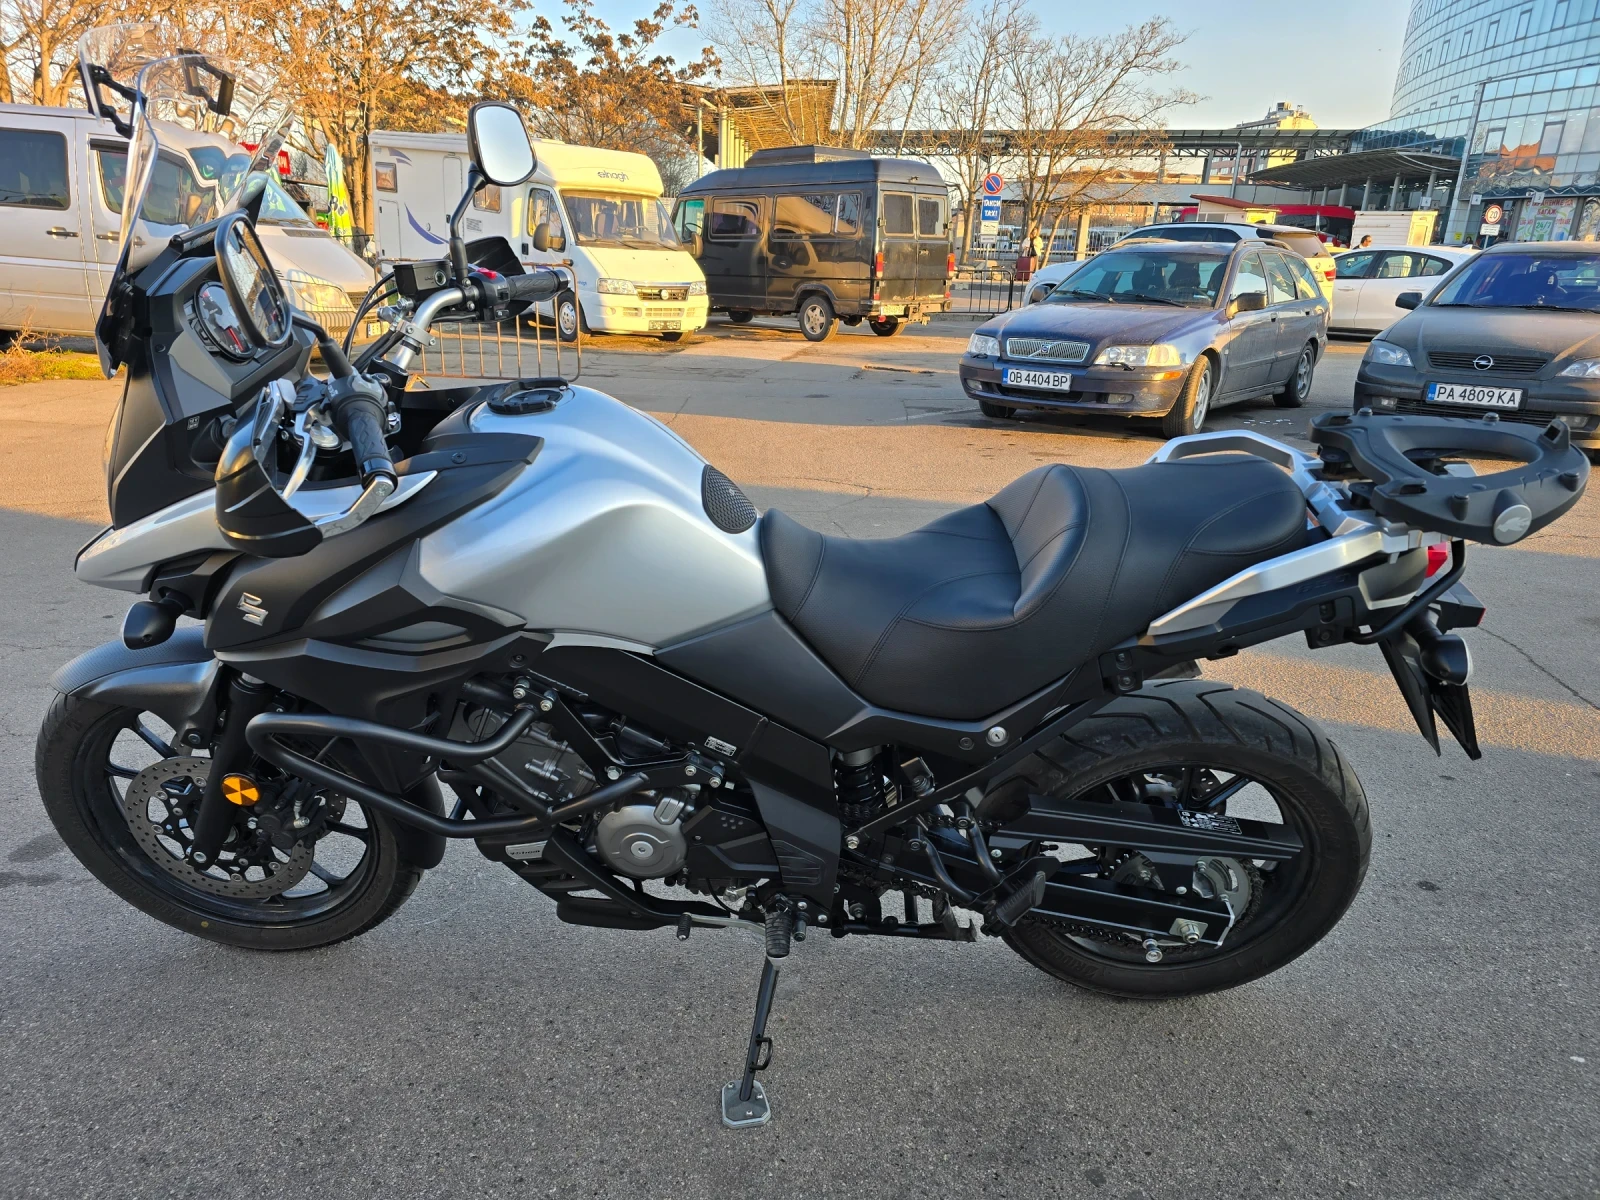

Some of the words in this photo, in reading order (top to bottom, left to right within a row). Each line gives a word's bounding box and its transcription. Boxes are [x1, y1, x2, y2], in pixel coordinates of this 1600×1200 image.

[985, 209, 997, 217] TAXI
[1489, 210, 1499, 219] 20
[1535, 221, 1553, 230] 24/7
[1009, 371, 1023, 384] OB
[1024, 372, 1051, 386] 4404
[1052, 375, 1068, 387] BP
[1436, 386, 1455, 401] PA
[1458, 387, 1496, 404] 4809
[1496, 390, 1517, 406] KA
